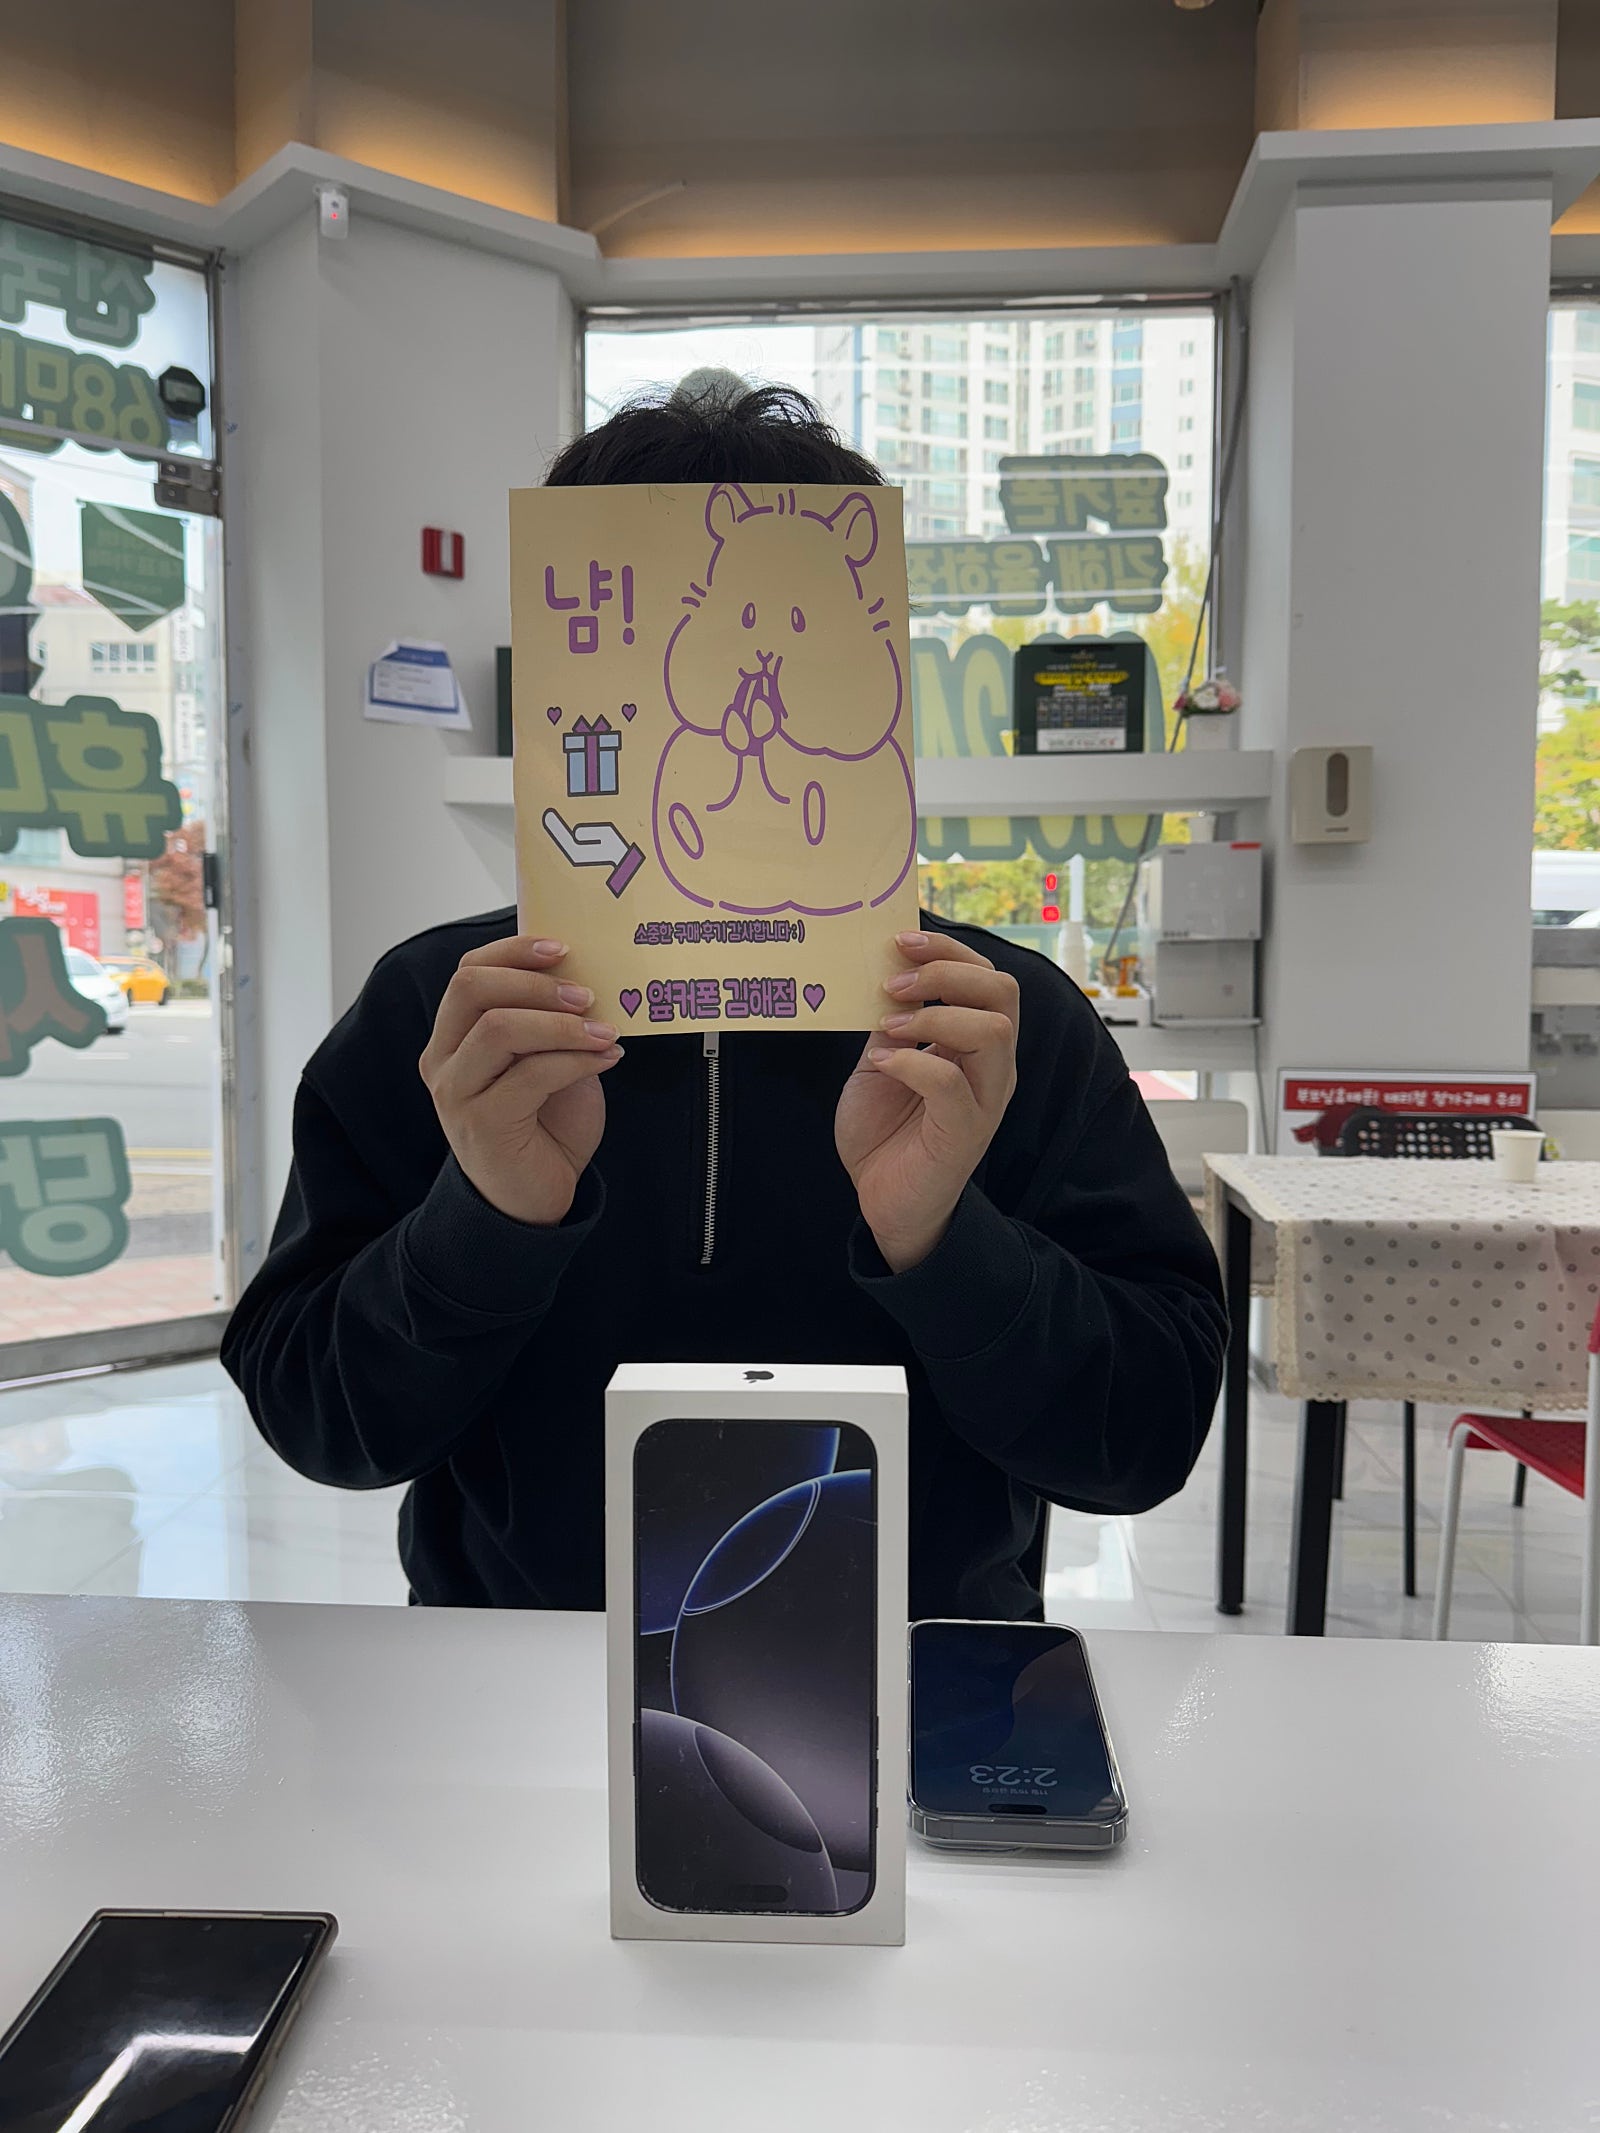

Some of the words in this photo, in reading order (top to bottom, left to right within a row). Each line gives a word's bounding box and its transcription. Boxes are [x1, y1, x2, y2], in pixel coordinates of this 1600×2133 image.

[545, 560, 635, 654] 냠!
[634, 922, 674, 945] 소중한
[674, 921, 701, 944] 구매
[701, 920, 727, 943] 후기
[646, 978, 721, 1022] 옆커폰
[723, 976, 798, 1019] 김해점
[969, 1764, 1058, 1787] 2:23
